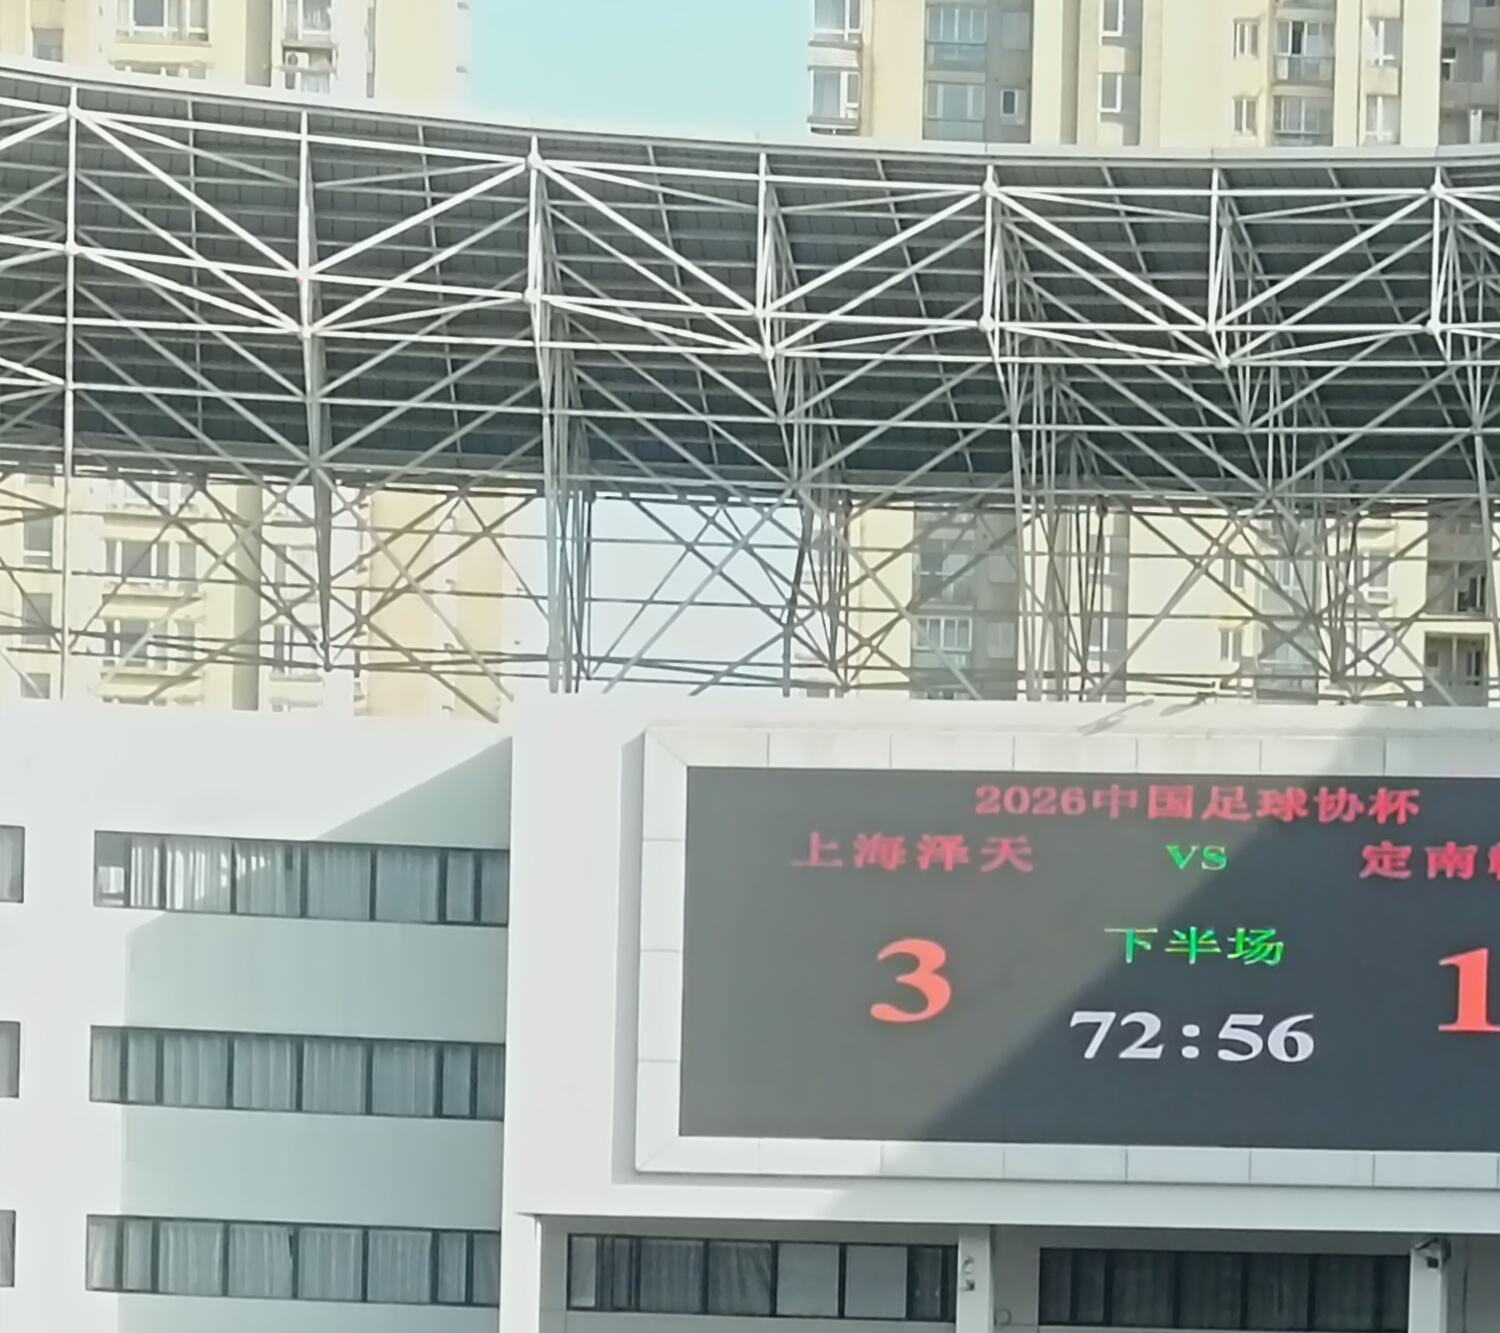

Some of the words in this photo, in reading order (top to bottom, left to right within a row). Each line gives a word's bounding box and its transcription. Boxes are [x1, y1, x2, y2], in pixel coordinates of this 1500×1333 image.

[975, 784, 1420, 824] 2026中国足球协杯
[791, 831, 1034, 872] 上海泽天
[1104, 926, 1284, 966] 下半场
[870, 938, 952, 1023] 3
[1070, 1011, 1315, 1063] 72:56
